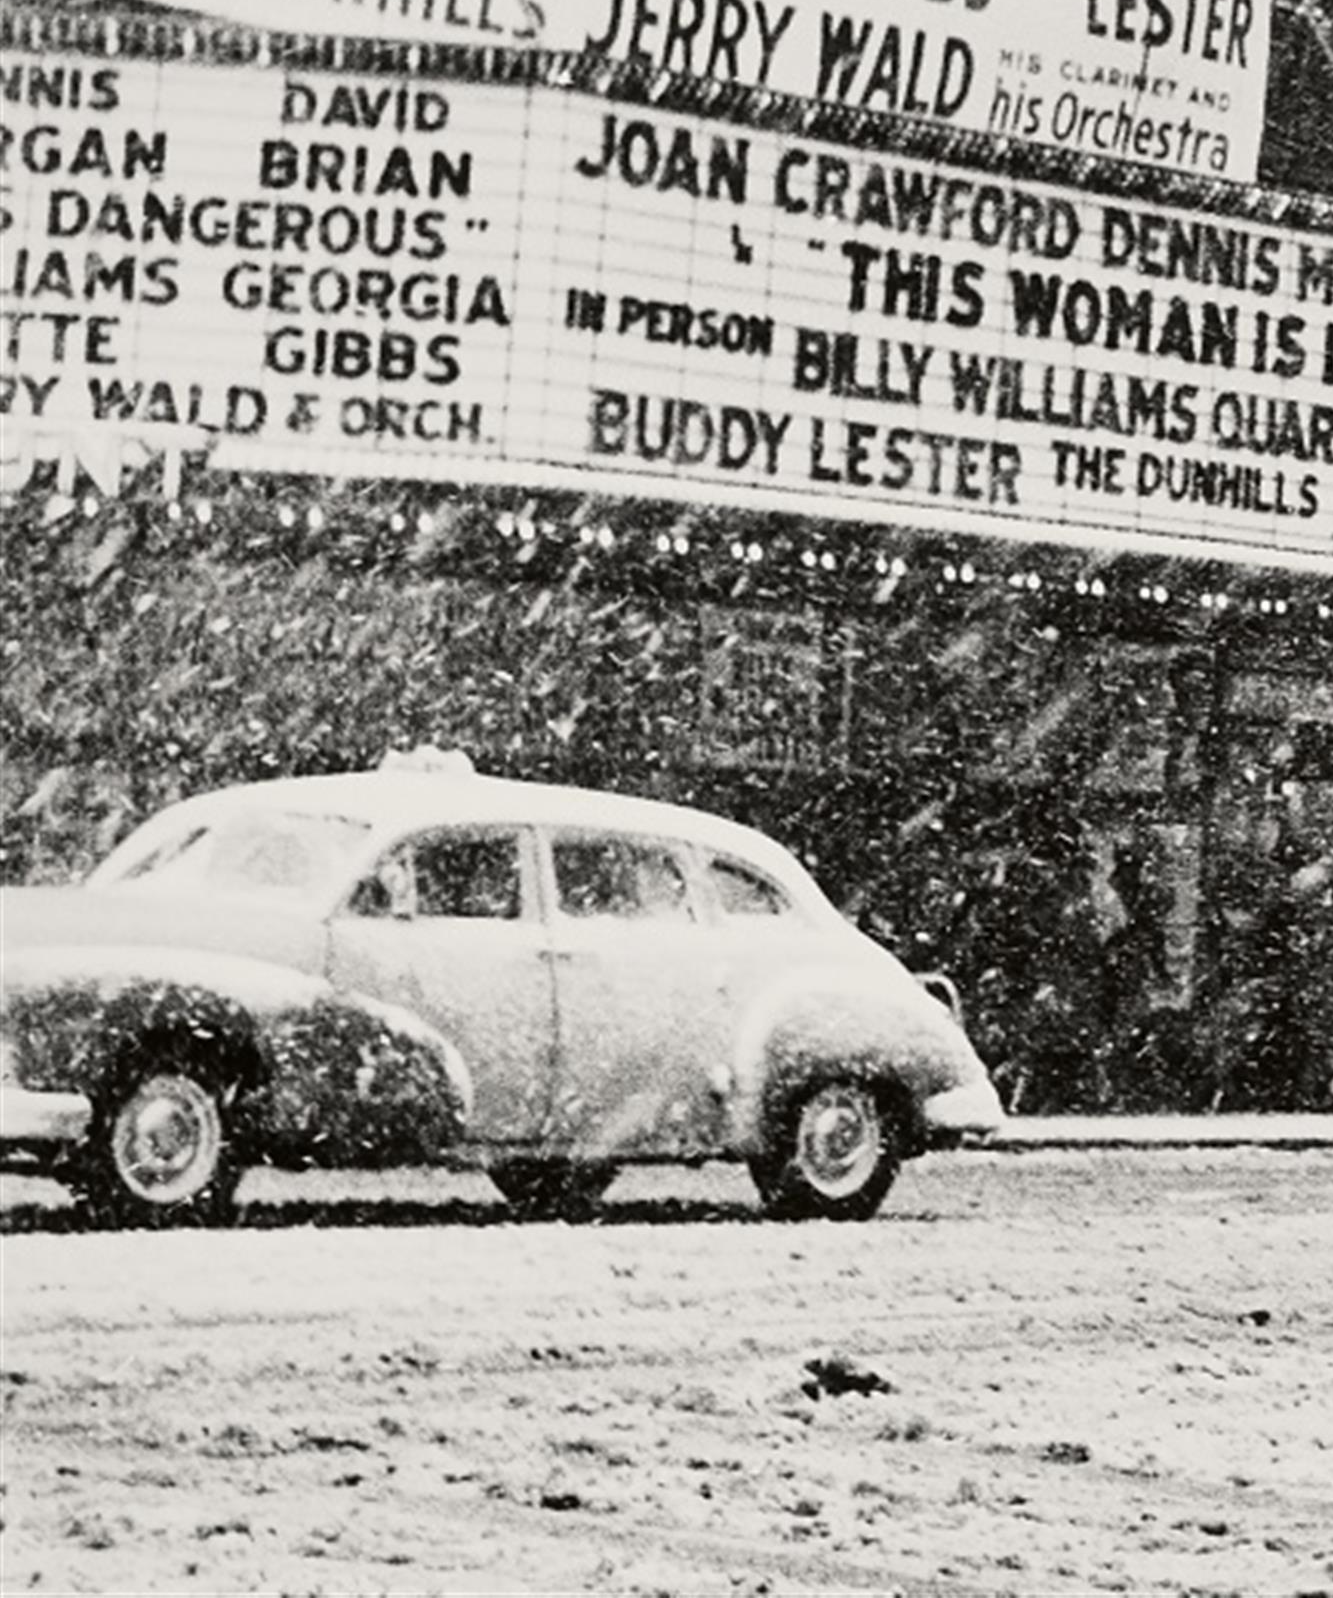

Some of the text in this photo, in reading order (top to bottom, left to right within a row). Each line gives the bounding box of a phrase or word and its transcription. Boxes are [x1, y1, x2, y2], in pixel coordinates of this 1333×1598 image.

[815, 10, 975, 119] WALD
[1000, 48, 1230, 112] HIS CLARINET AND
[281, 84, 450, 133] DAVID
[990, 78, 1229, 172] his Orchestra
[260, 139, 472, 198] BRIAN
[575, 116, 749, 204] JOAN
[774, 148, 1082, 259] CRAWFORD
[1102, 207, 1280, 297] DENNIS
[222, 261, 511, 327] GEORGIA
[1008, 268, 1239, 369] WOMAN
[1252, 311, 1306, 377] IS
[265, 326, 461, 385] GIBBS
[566, 288, 606, 331] IN
[618, 296, 775, 355] PERSON
[795, 327, 935, 406] BILLY
[949, 350, 1197, 445] WILLIAMS
[88, 377, 269, 436] WALD
[287, 393, 320, 433] &
[338, 396, 497, 445] ORCH.
[588, 389, 791, 475] BUDDY
[811, 416, 1022, 504] LESTER
[1051, 441, 1125, 494] THE
[1136, 452, 1319, 518] DUNHILLS
